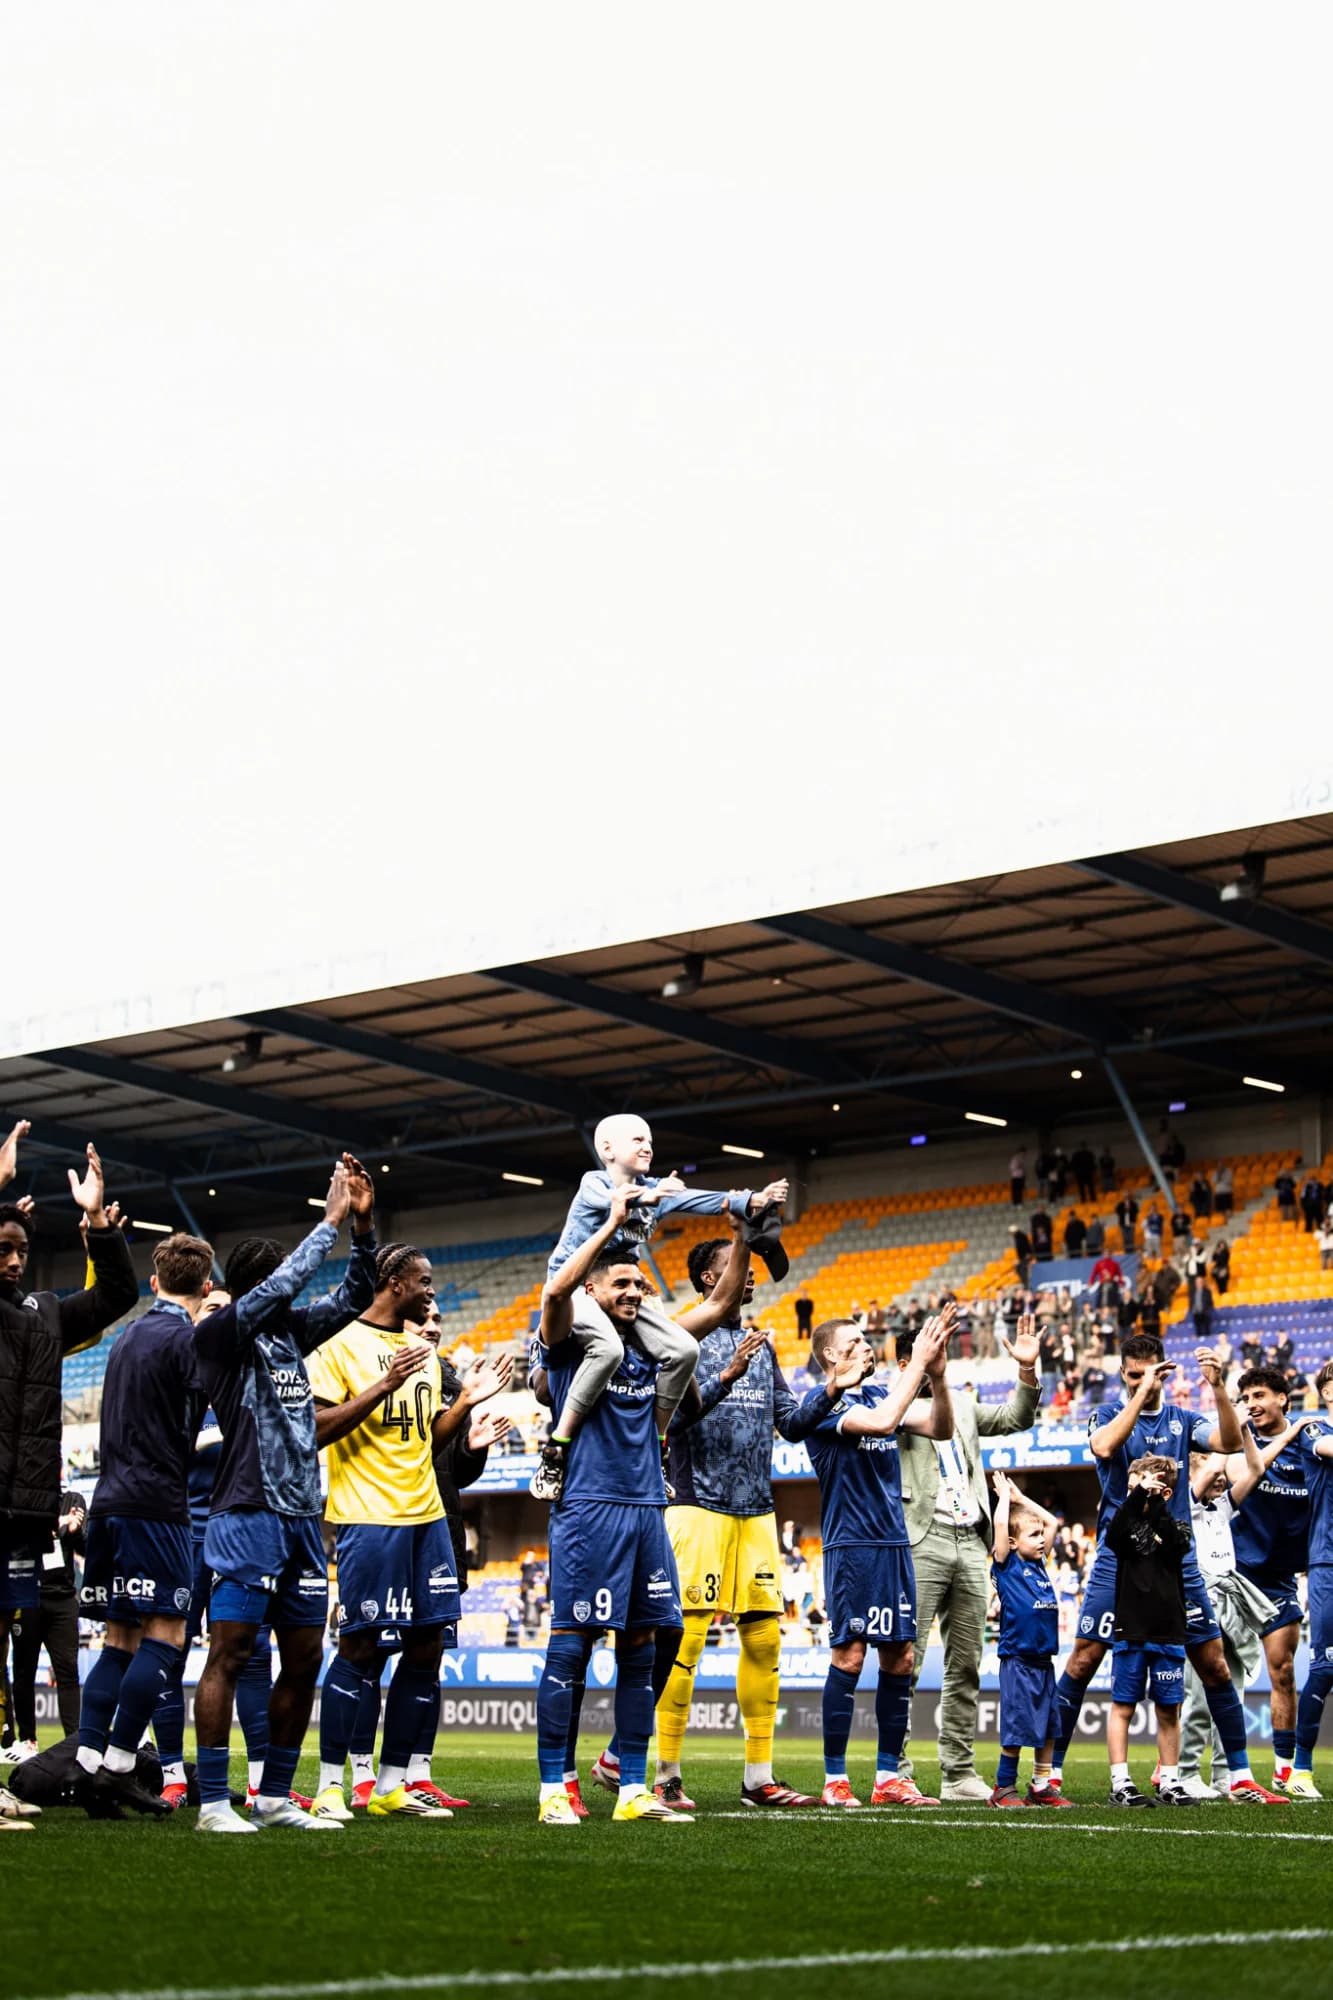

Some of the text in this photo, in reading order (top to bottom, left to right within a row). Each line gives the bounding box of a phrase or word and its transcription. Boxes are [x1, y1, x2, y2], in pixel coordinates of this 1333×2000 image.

[382, 1381, 432, 1442] 40
[1258, 1481, 1309, 1496] AMPLITUD
[80, 1586, 108, 1603] CR
[127, 1578, 155, 1597] CR
[385, 1587, 413, 1620] 44
[595, 1587, 612, 1621] 9
[867, 1606, 893, 1636] 20
[1098, 1611, 1115, 1639] 6
[443, 1700, 538, 1732] BOUTIQU
